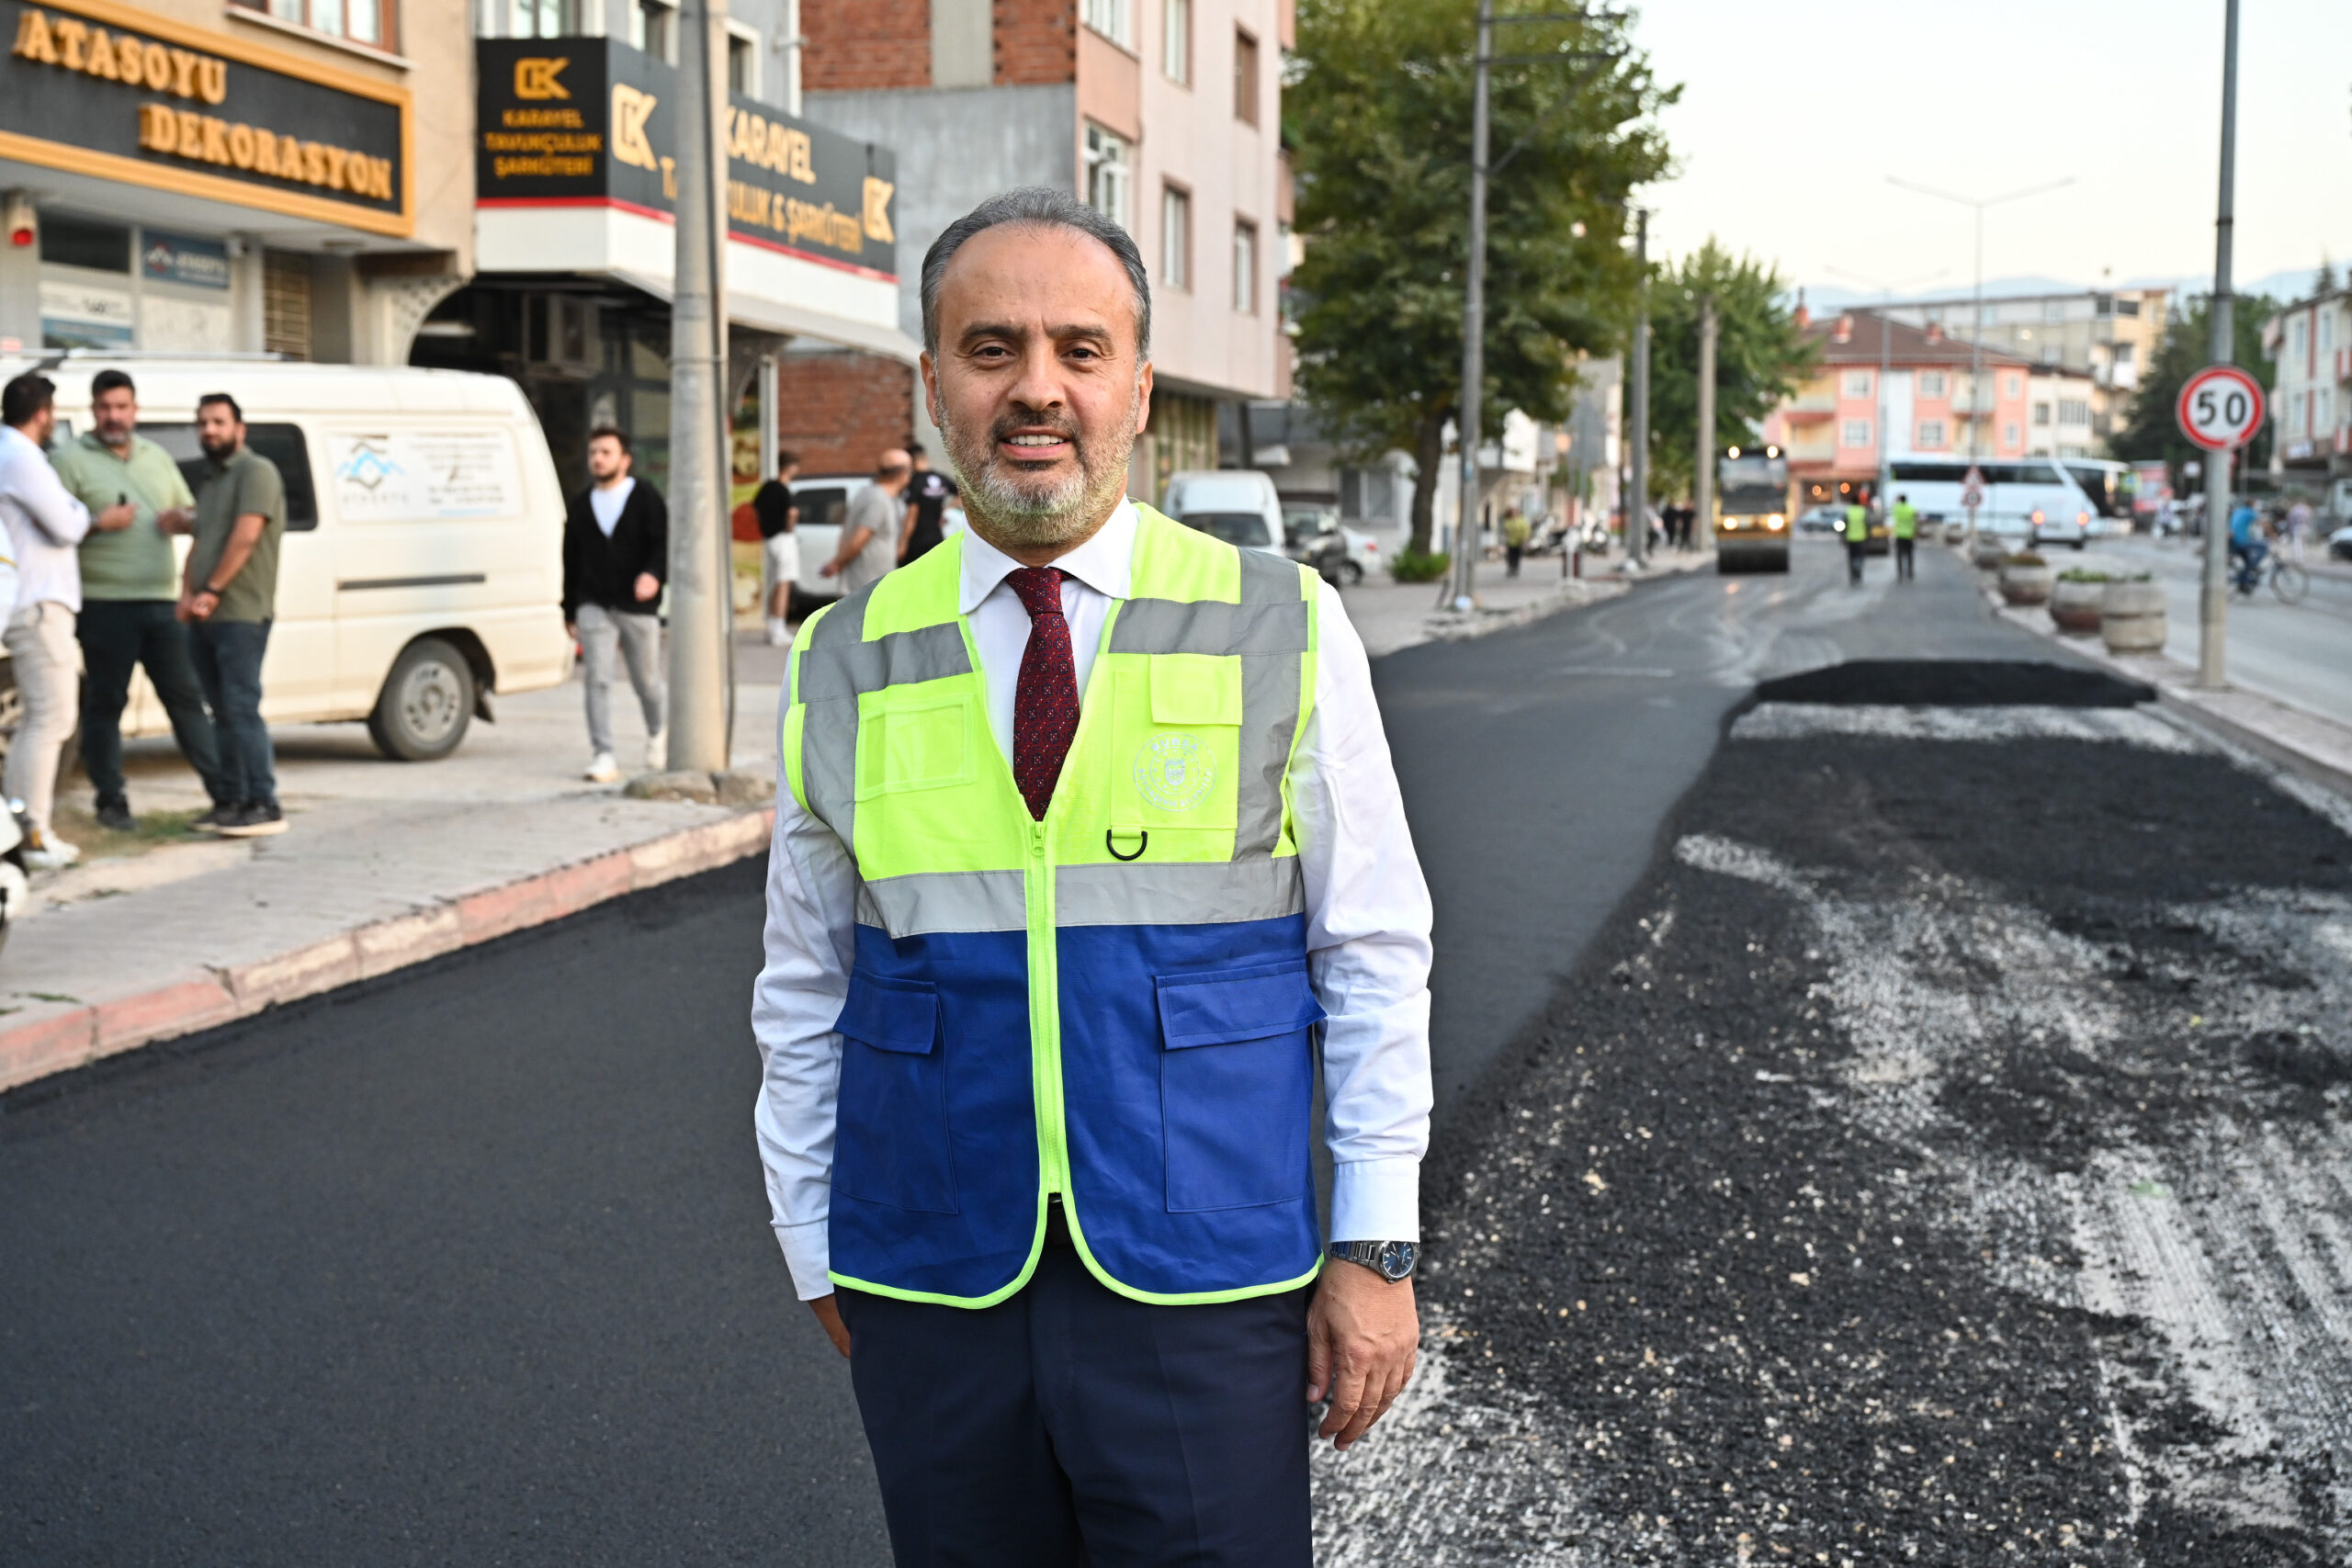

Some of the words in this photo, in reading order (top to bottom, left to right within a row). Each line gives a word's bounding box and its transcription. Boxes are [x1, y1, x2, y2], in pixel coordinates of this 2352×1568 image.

[13, 9, 228, 105] ATASOYU
[502, 109, 584, 129] KARAYEL
[140, 103, 393, 200] DEKORASYON
[2196, 389, 2248, 428] 50
[1150, 738, 1198, 751] BURSA
